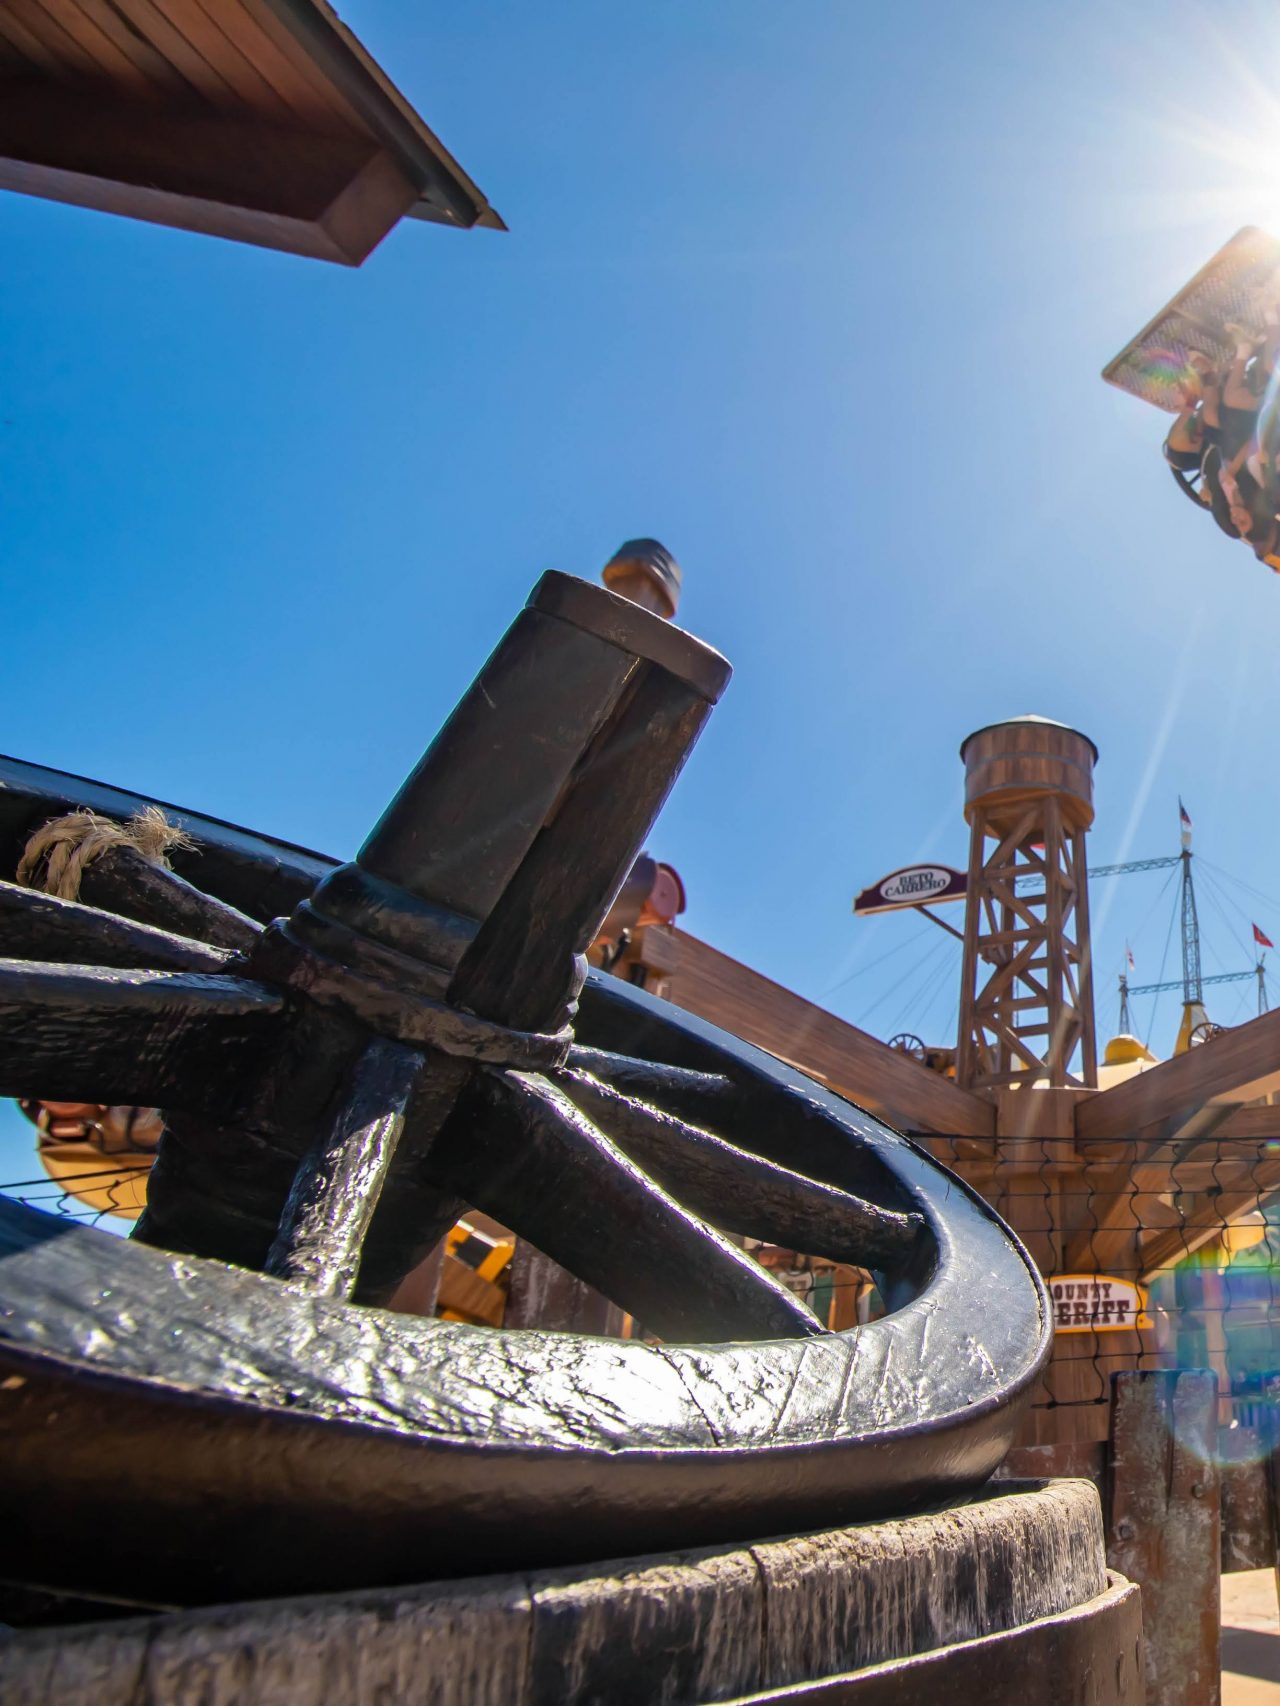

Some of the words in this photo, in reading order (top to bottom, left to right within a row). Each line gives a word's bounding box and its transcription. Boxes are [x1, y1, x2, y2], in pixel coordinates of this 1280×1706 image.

[899, 871, 934, 886] BETO
[885, 879, 946, 897] CARRERO
[1053, 1283, 1112, 1300] OUNTY
[1057, 1300, 1130, 1326] ERIFF
